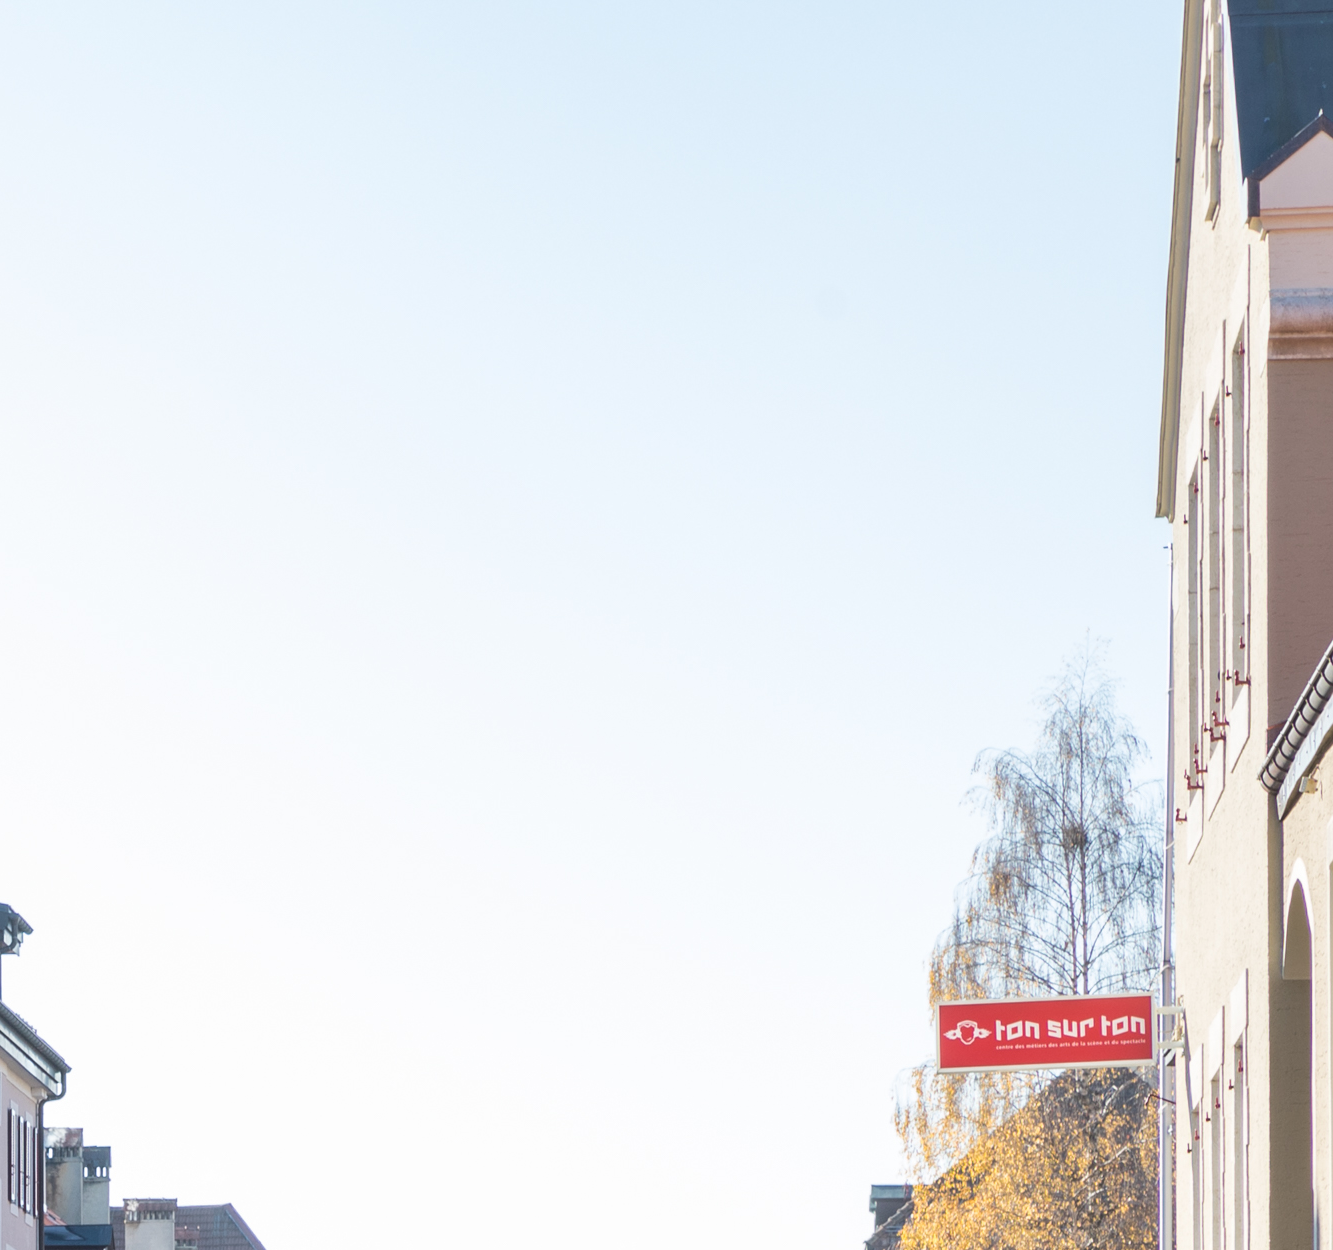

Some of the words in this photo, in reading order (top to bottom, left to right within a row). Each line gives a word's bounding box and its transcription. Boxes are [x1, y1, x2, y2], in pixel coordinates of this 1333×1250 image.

[995, 1019, 1040, 1041] ton
[1047, 1017, 1094, 1039] sur
[1101, 1015, 1146, 1037] ton
